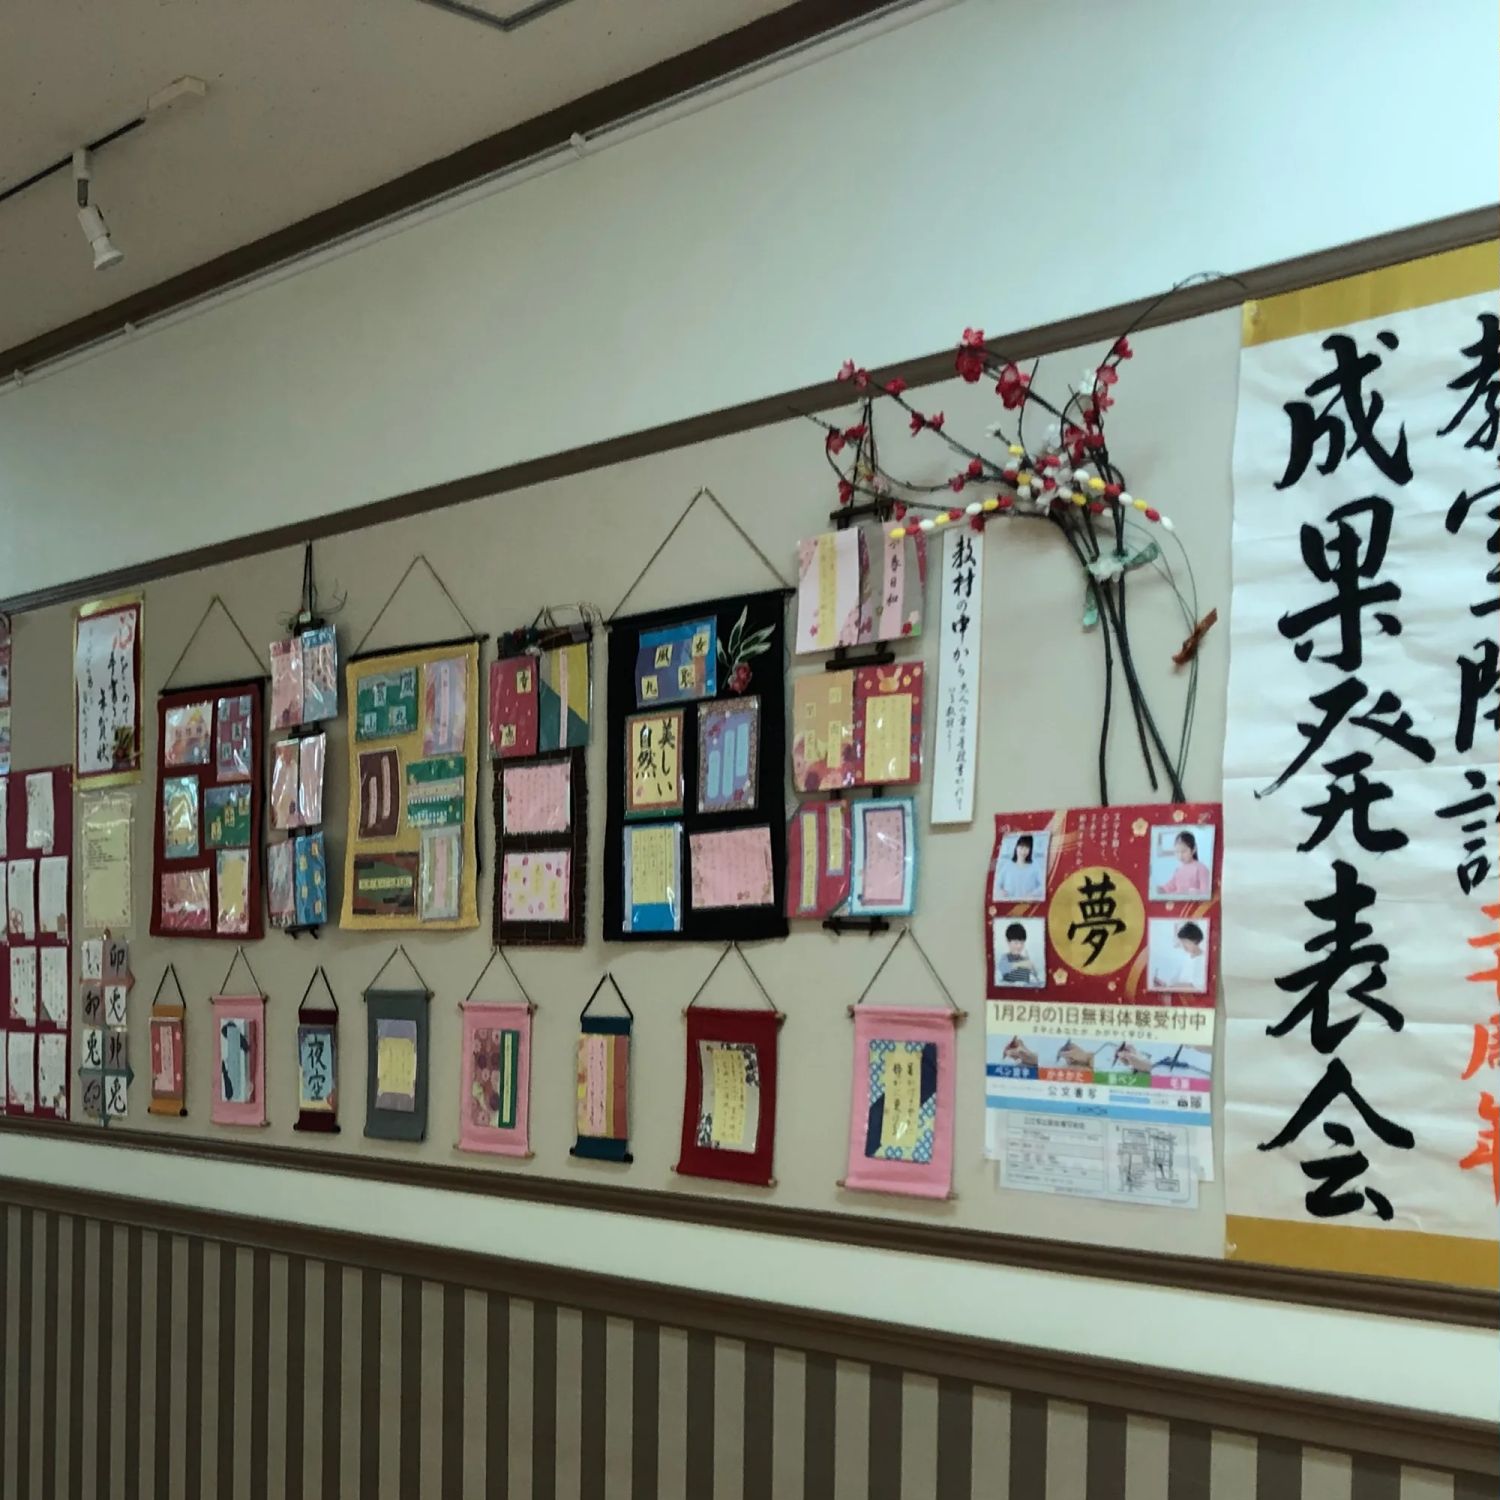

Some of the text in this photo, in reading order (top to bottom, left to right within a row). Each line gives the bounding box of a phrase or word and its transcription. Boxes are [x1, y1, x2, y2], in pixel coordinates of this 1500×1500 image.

[634, 724, 658, 780] 自然
[657, 717, 676, 795] 美しい
[1254, 331, 1435, 1216] 成果発表会
[1068, 872, 1126, 967] 夢
[993, 1004, 1206, 1030] 1月2月の1日無料体験受付中
[306, 1035, 328, 1101] 夜空
